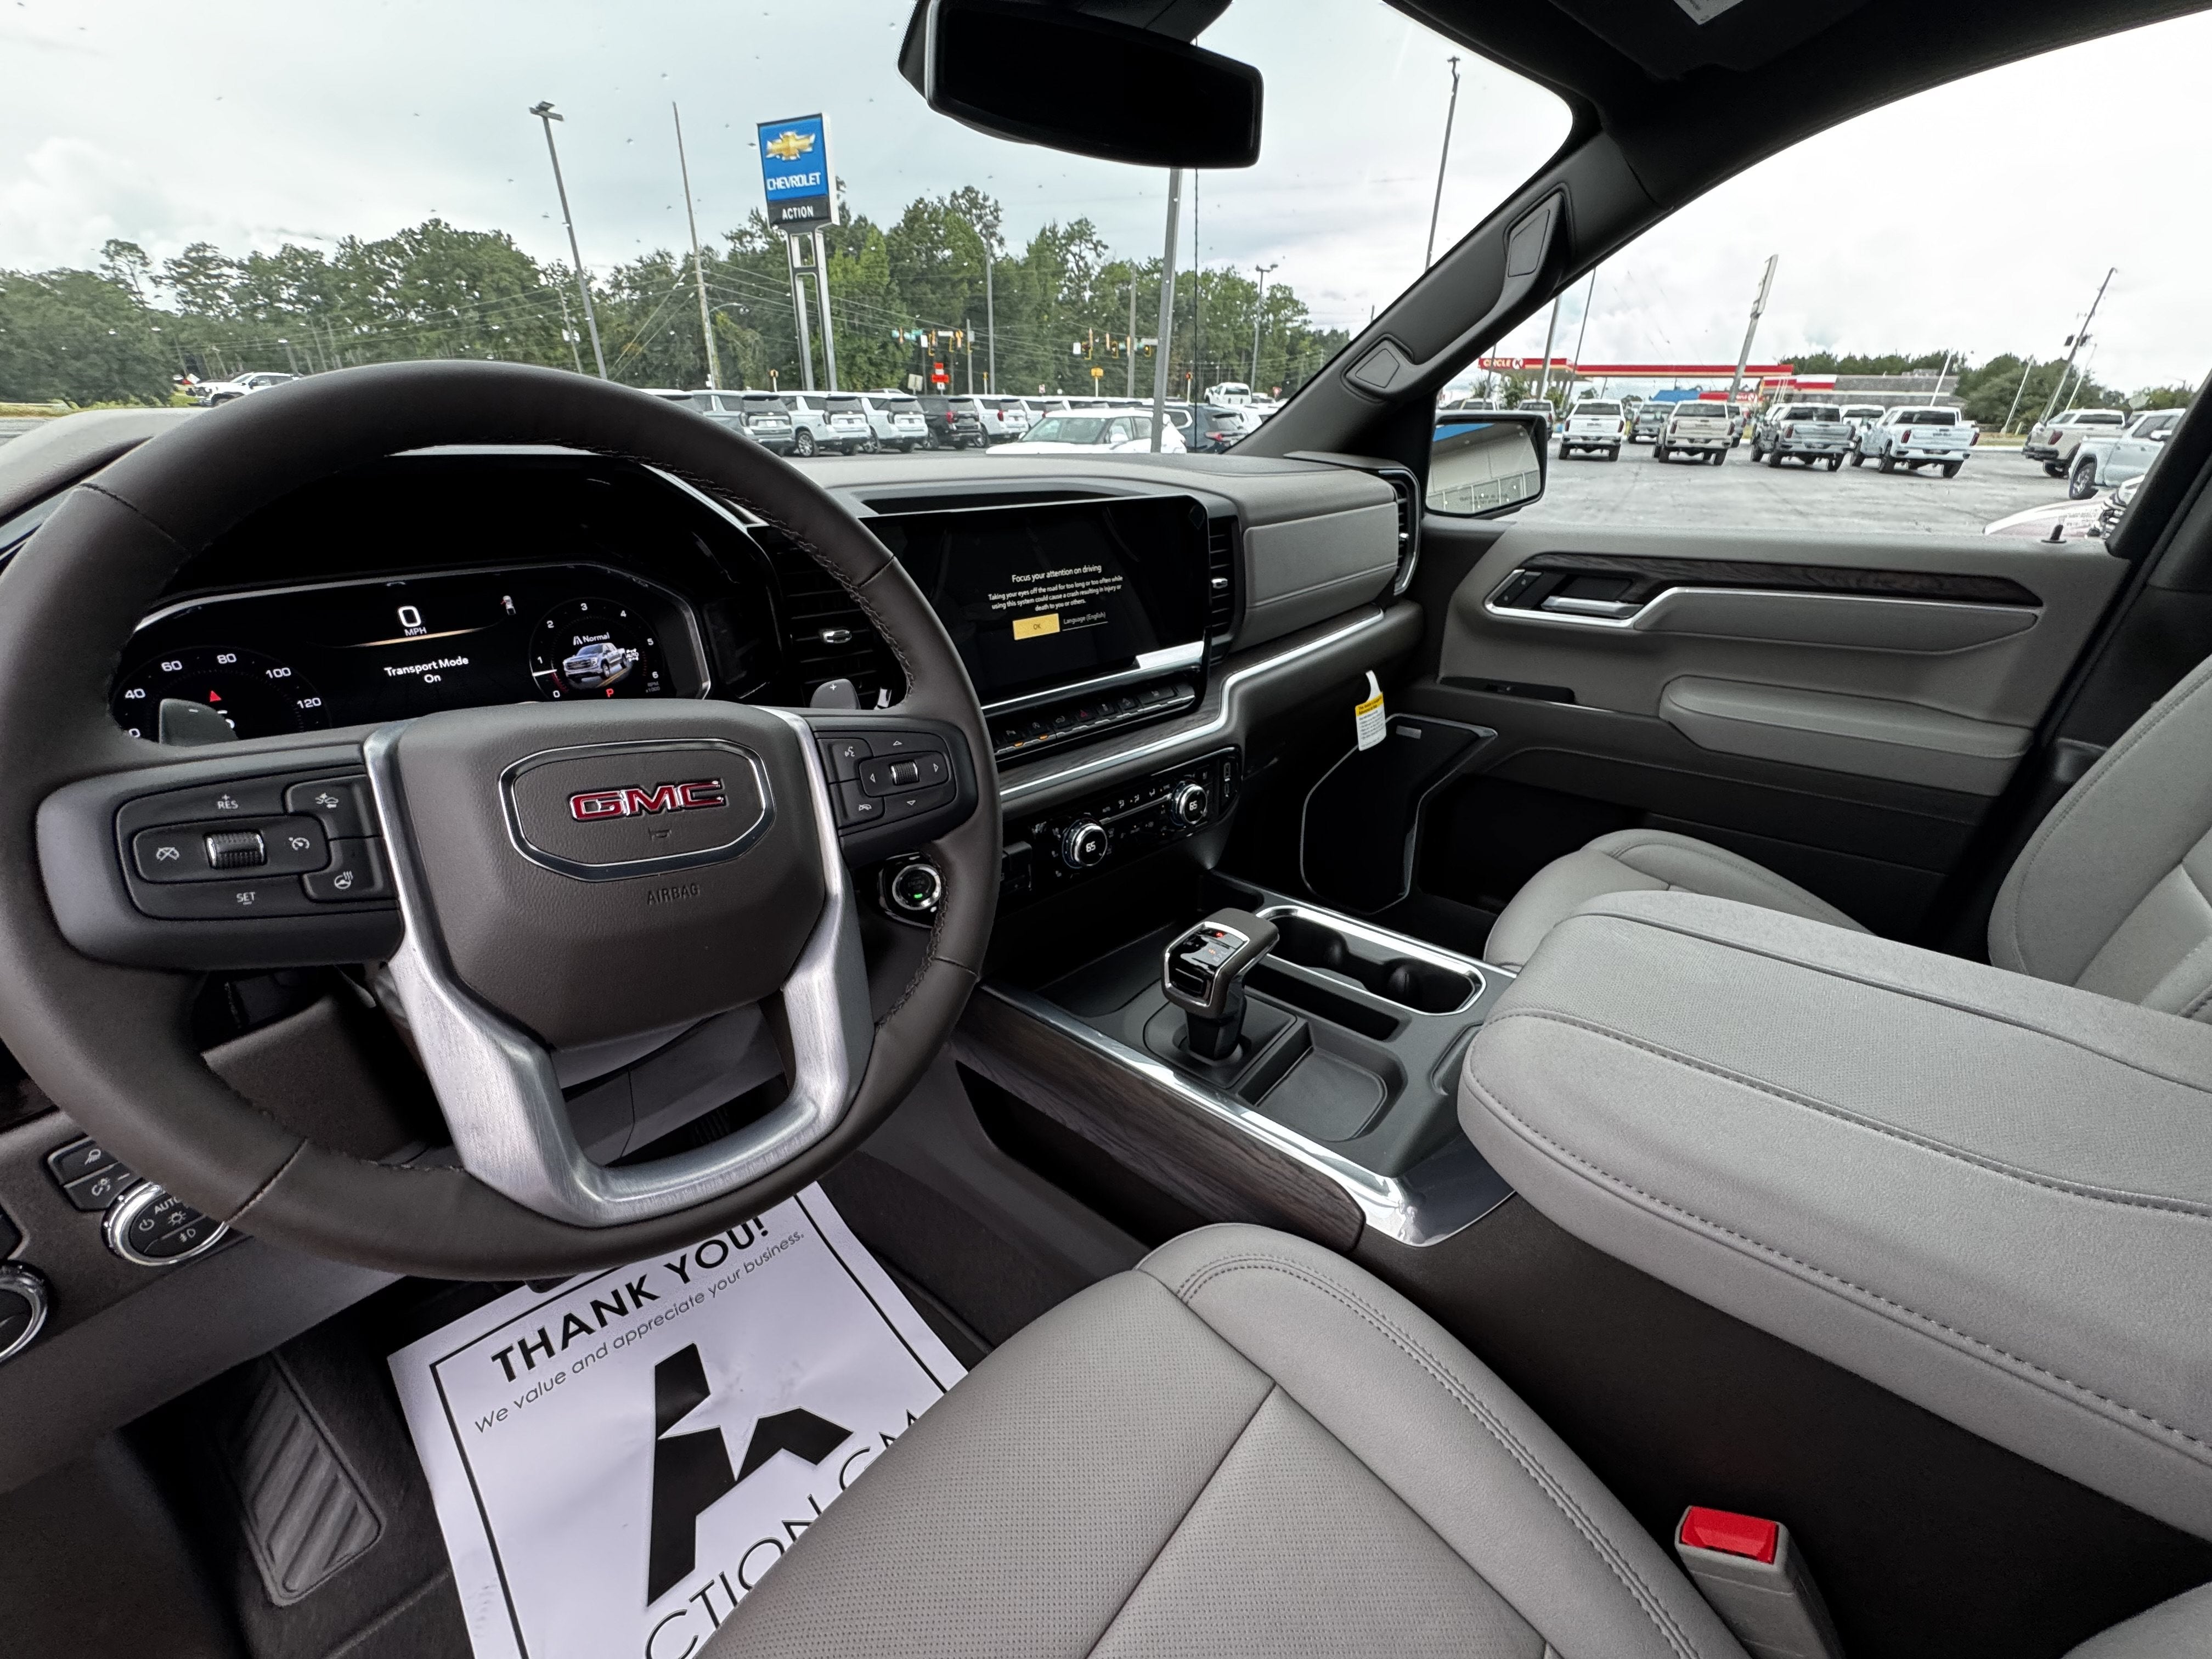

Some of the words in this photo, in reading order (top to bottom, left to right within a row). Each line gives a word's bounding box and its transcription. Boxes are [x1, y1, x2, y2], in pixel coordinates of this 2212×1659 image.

[767, 172, 821, 191] CHEVROLET
[782, 206, 814, 220] ACTION
[1012, 574, 1031, 583] Focus
[1031, 573, 1046, 583] your
[1046, 568, 1074, 578] attention
[1082, 565, 1102, 574] driving
[1006, 592, 1017, 600] your
[1017, 599, 1035, 607] system
[1035, 594, 1048, 602] could
[580, 603, 588, 611] 3
[397, 605, 422, 628] 0
[620, 610, 627, 618] 4
[1086, 612, 1106, 621] (English)
[404, 627, 427, 636] MPH
[582, 631, 610, 643] Normal
[217, 653, 237, 664] 80
[161, 660, 183, 672] 60
[384, 661, 438, 677] Transport
[439, 656, 469, 669] Mode
[266, 667, 291, 679] 100
[424, 674, 442, 684] On
[652, 671, 658, 679] 6
[125, 688, 145, 699] 40
[606, 688, 614, 698] P
[297, 697, 321, 709] 120
[128, 728, 140, 738] 0
[217, 799, 239, 810] RES
[569, 780, 725, 820] GMC
[1189, 800, 1198, 811] 65
[1086, 840, 1096, 853] 65
[236, 891, 256, 903] SET
[646, 883, 701, 905] AIRBAG
[490, 1273, 661, 1383] THANK
[663, 1216, 769, 1284] YOU!
[475, 1408, 509, 1433] We
[514, 1371, 567, 1409] value
[572, 1342, 608, 1374] and
[613, 1292, 705, 1349] appreciate
[708, 1269, 741, 1299] your
[743, 1231, 804, 1274] business.
